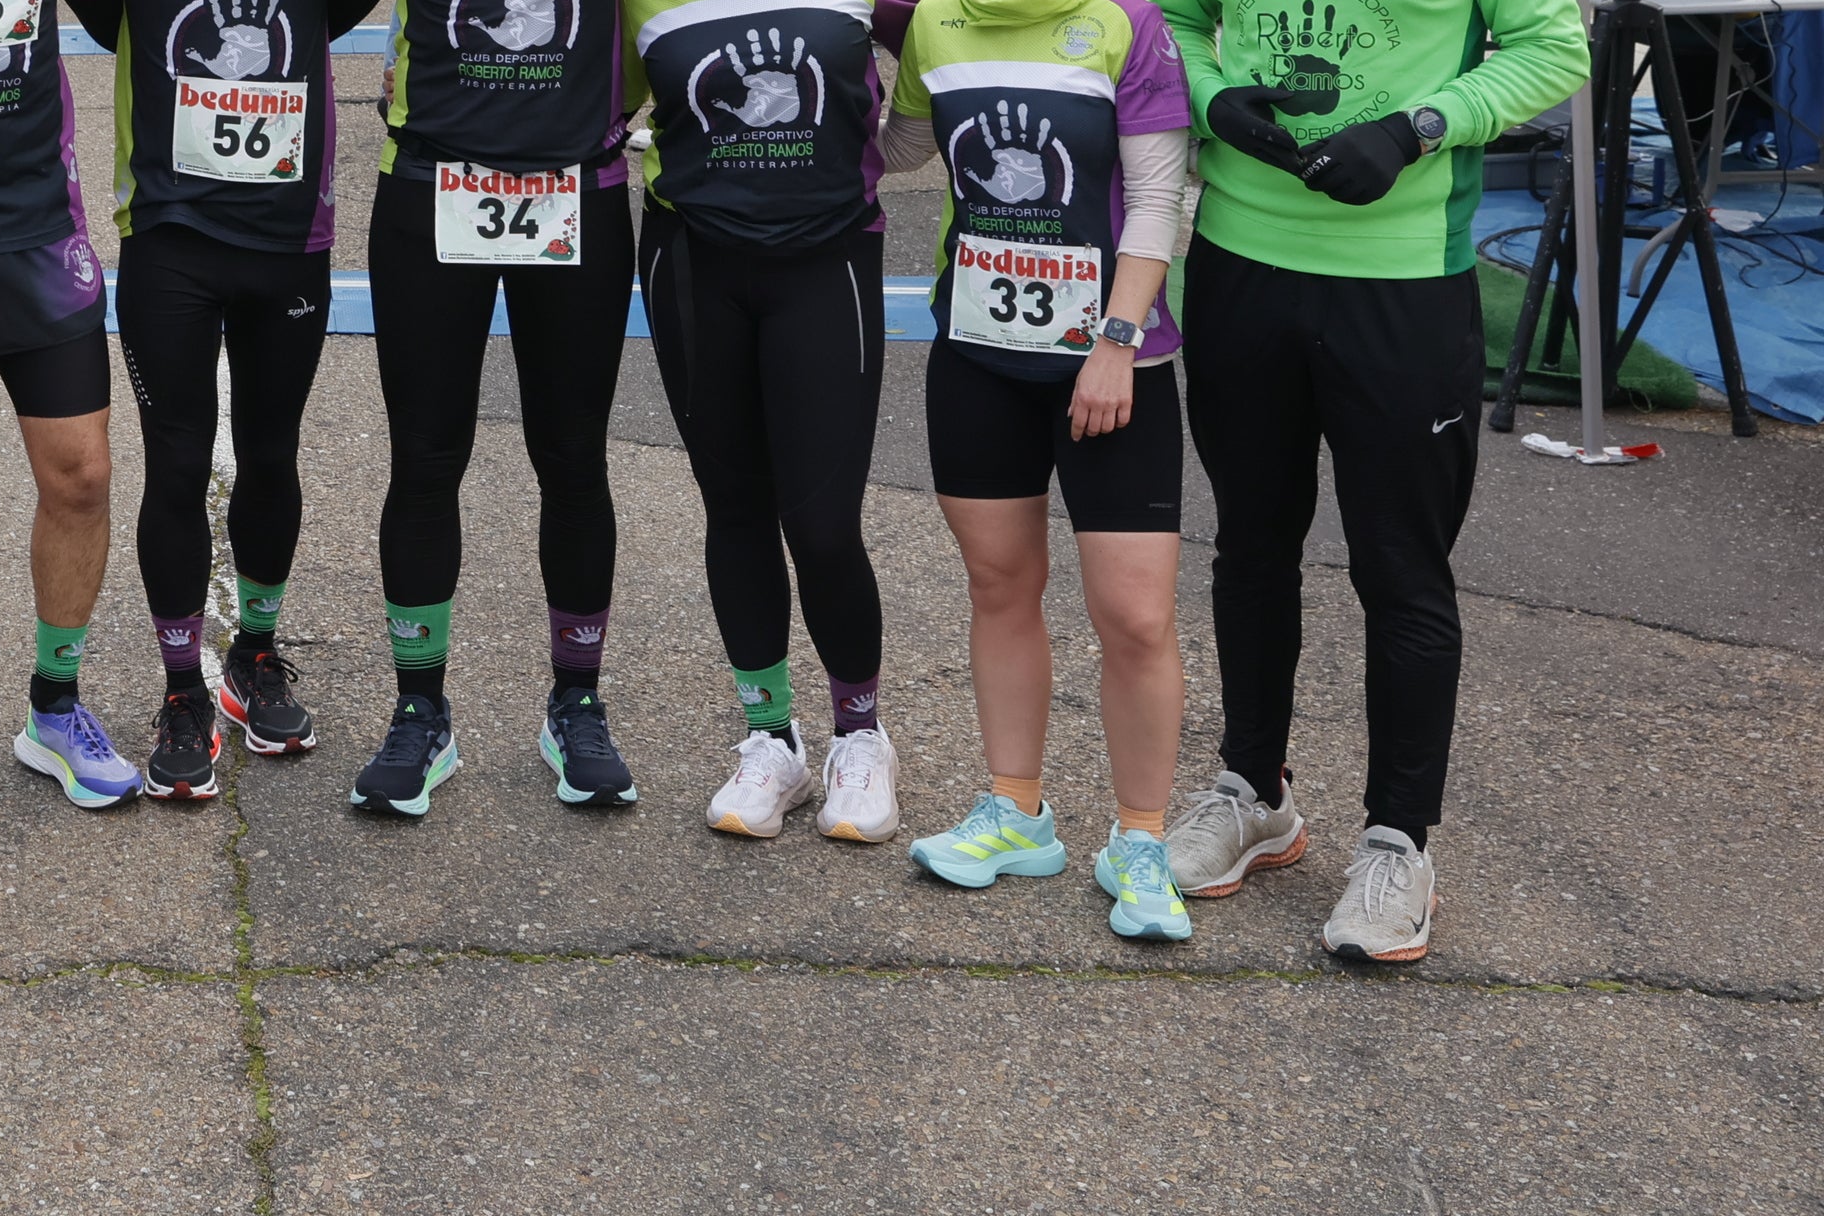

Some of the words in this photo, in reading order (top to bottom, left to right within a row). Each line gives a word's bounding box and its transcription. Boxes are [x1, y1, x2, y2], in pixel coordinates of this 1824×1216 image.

[1257, 13, 1376, 50] Roberto
[461, 53, 490, 63] CLUB
[496, 53, 564, 63] DEPORTIVO
[459, 64, 515, 79] ROBERTO
[519, 65, 562, 80] RAMOS
[1272, 54, 1365, 91] Ramos
[460, 79, 562, 90] FISIOTERAPIA
[180, 83, 303, 115] bedunia
[213, 114, 271, 159] 56
[743, 130, 813, 141] DEPORTIVO
[768, 142, 814, 157] RAMOS
[706, 159, 814, 169] FISIOTERAPIA
[441, 168, 576, 195] bedunia
[476, 197, 539, 239] 34
[993, 207, 1061, 218] DEPORTIVO
[1017, 220, 1062, 234] RAMOS
[958, 242, 1096, 281] bedunia
[287, 300, 315, 318] spyro
[989, 277, 1054, 327] 33
